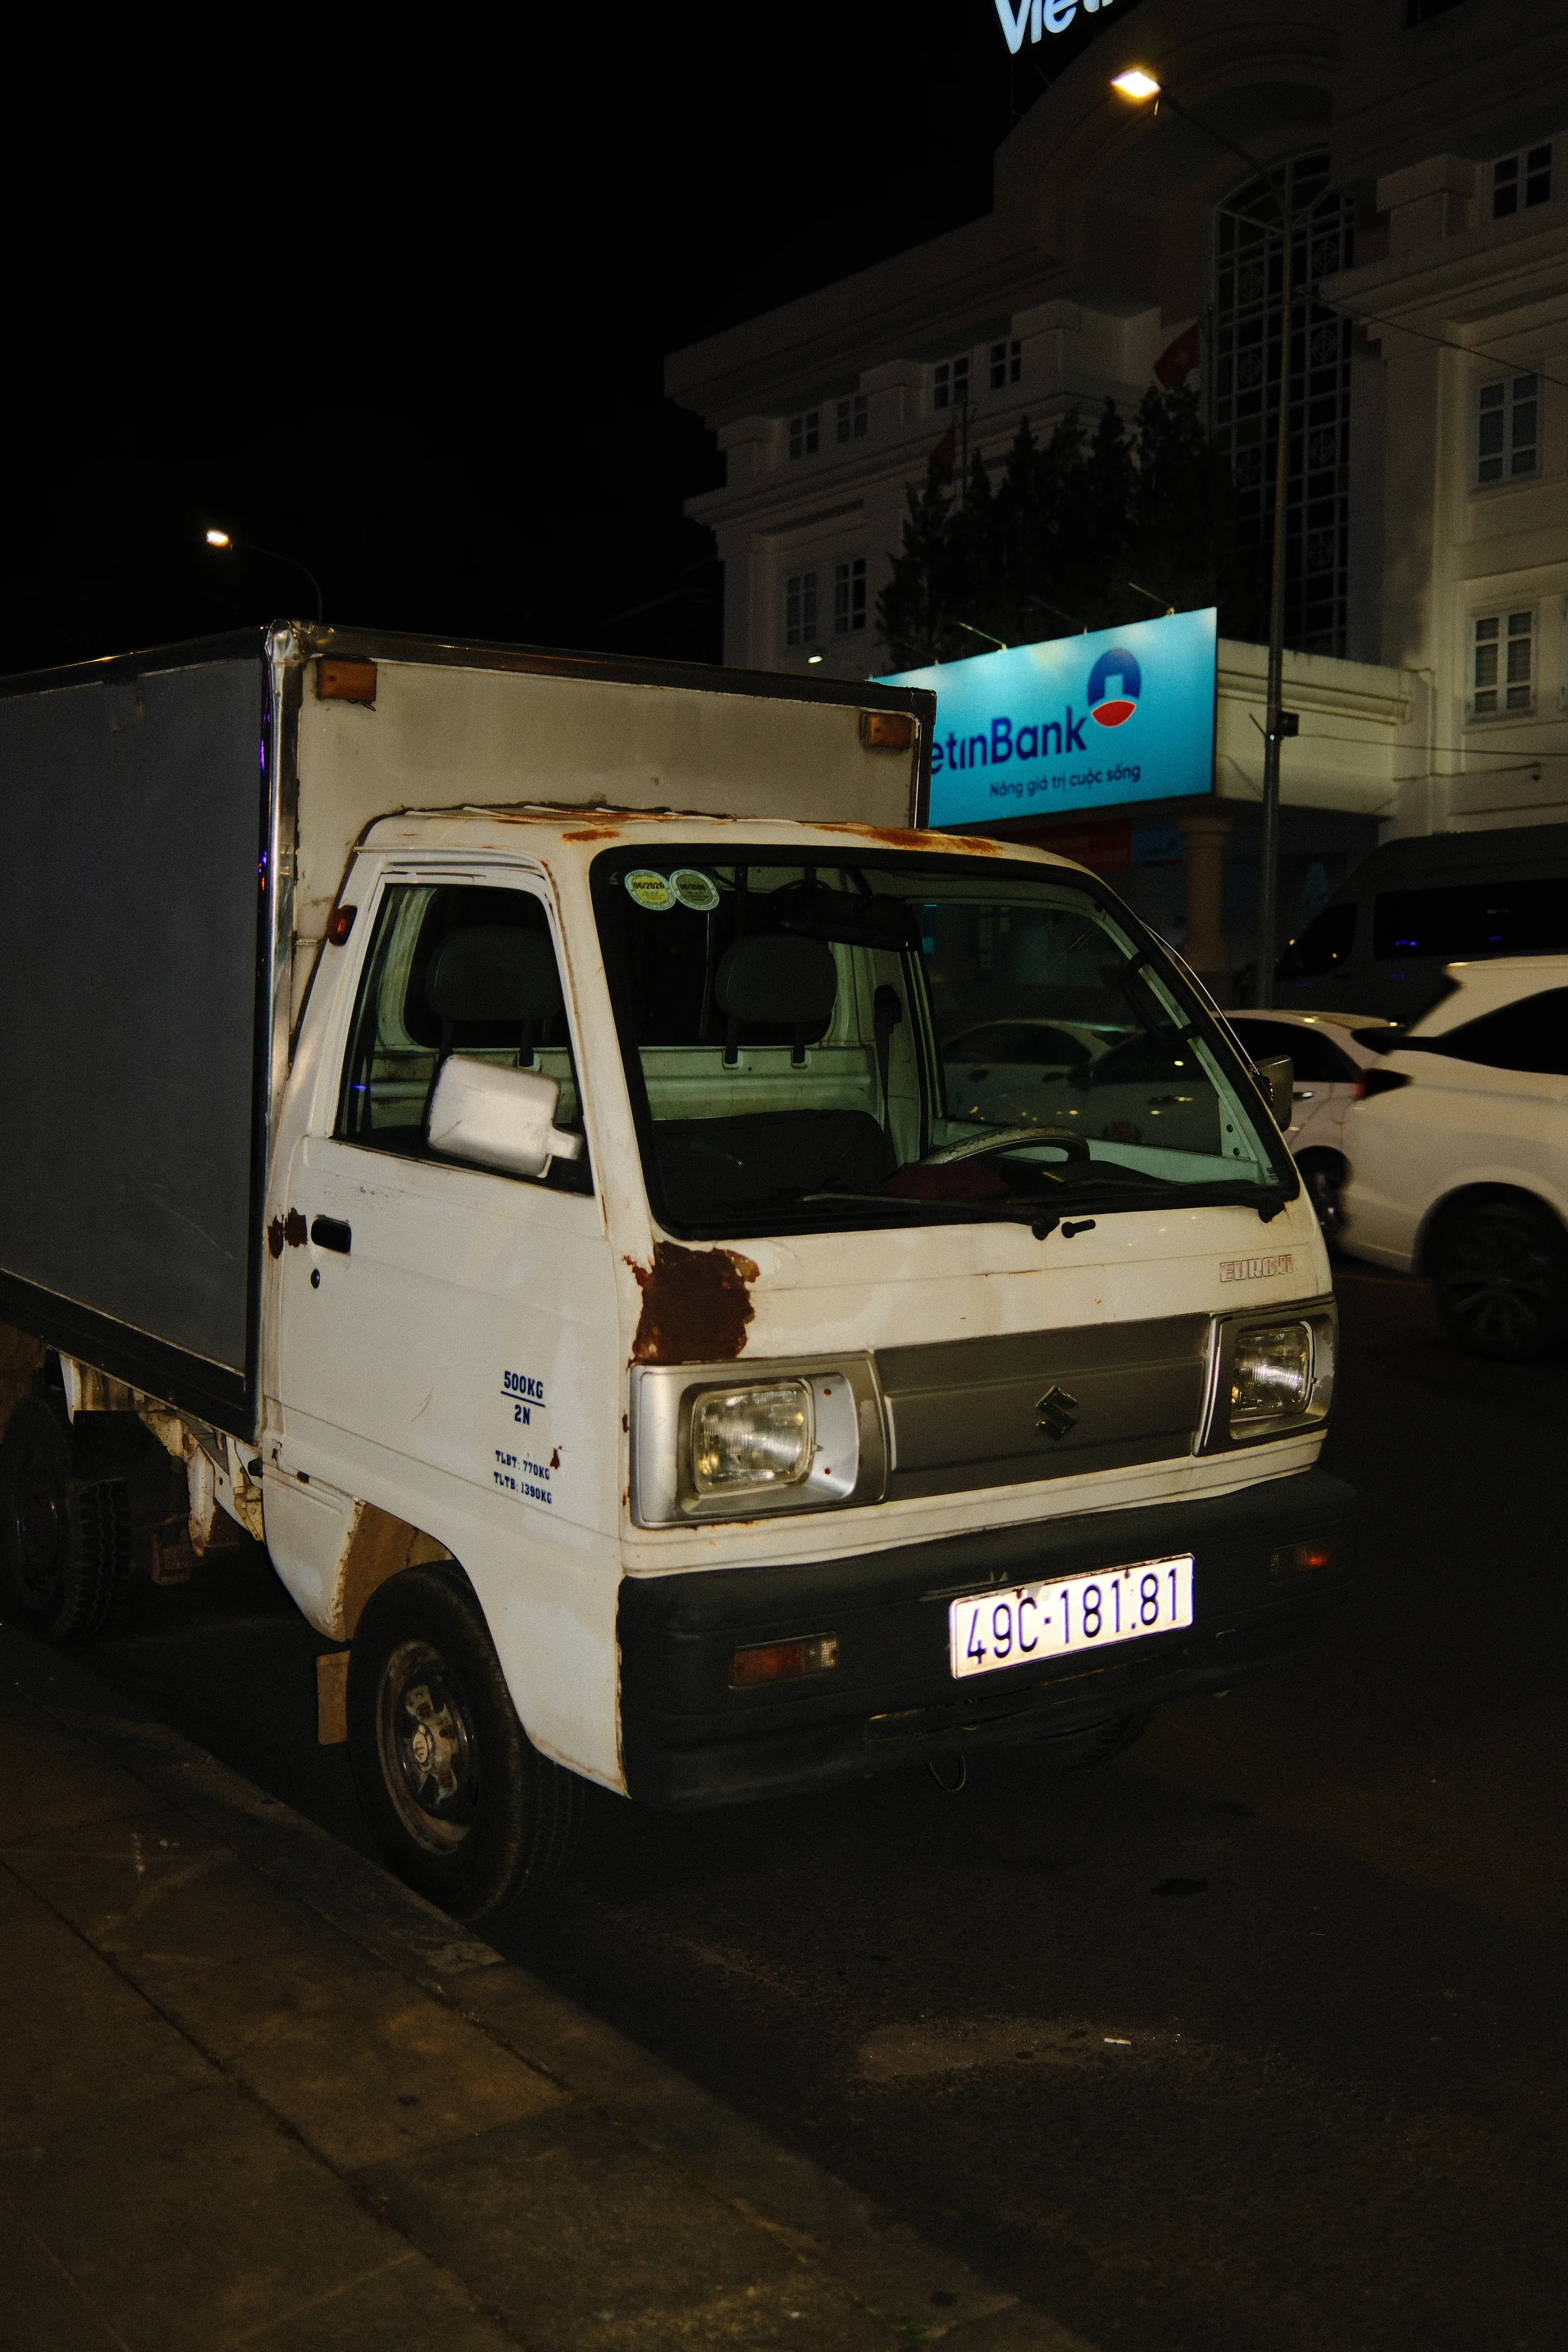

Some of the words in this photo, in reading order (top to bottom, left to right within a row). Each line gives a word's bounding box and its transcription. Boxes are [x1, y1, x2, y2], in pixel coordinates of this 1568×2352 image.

[994, 0, 1113, 54] Vie
[1052, 773, 1066, 792] trị
[1069, 769, 1102, 789] cuộc
[1107, 761, 1141, 783] sống
[1219, 1257, 1275, 1282] EURO
[504, 1370, 544, 1399] 500KG
[514, 1404, 531, 1425] 2N
[495, 1449, 520, 1470] TLBT:
[523, 1460, 550, 1480] 770KG
[493, 1471, 519, 1492] TLTB:
[521, 1482, 552, 1503] 1390KG
[966, 1568, 1177, 1665] 49C-181.81
